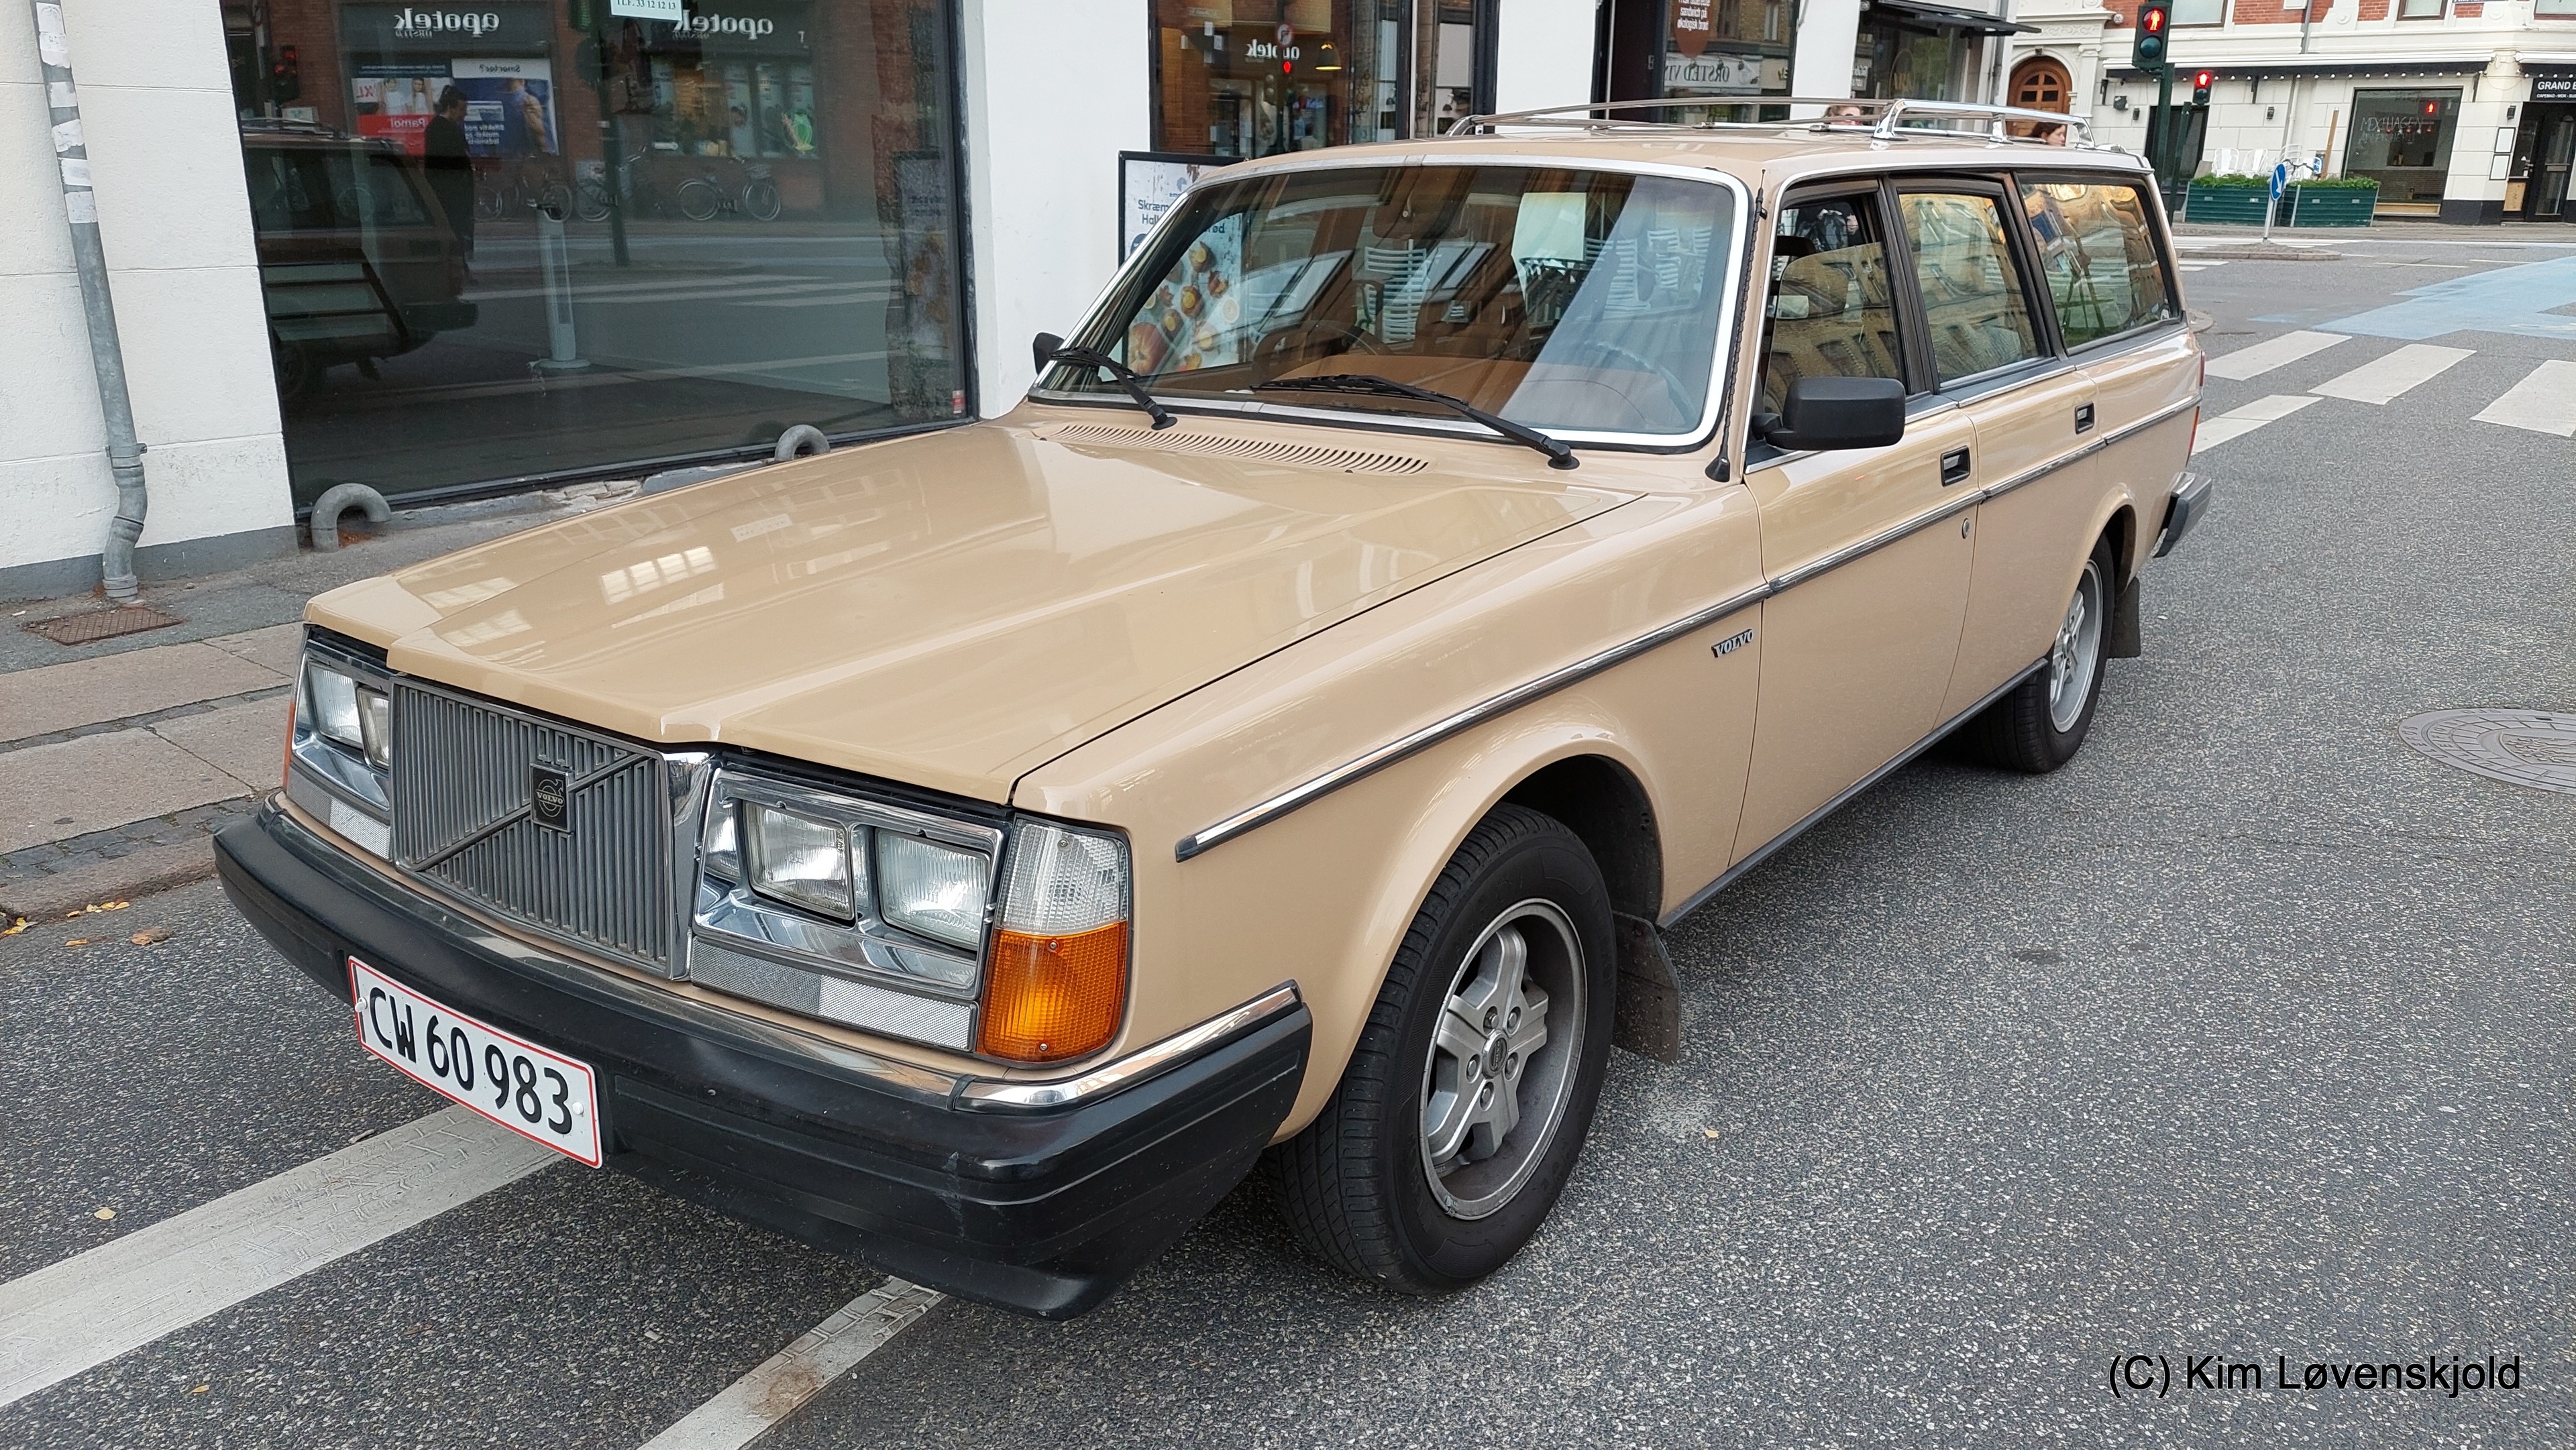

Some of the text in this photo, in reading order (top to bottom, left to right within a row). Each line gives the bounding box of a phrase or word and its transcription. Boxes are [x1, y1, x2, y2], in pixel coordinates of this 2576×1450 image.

[2538, 81, 2571, 90] GRAND
[1138, 199, 1170, 212] Skræm
[1711, 628, 1754, 658] VOLVO
[536, 791, 564, 804] VOLVO
[370, 987, 572, 1134] CW 60 983
